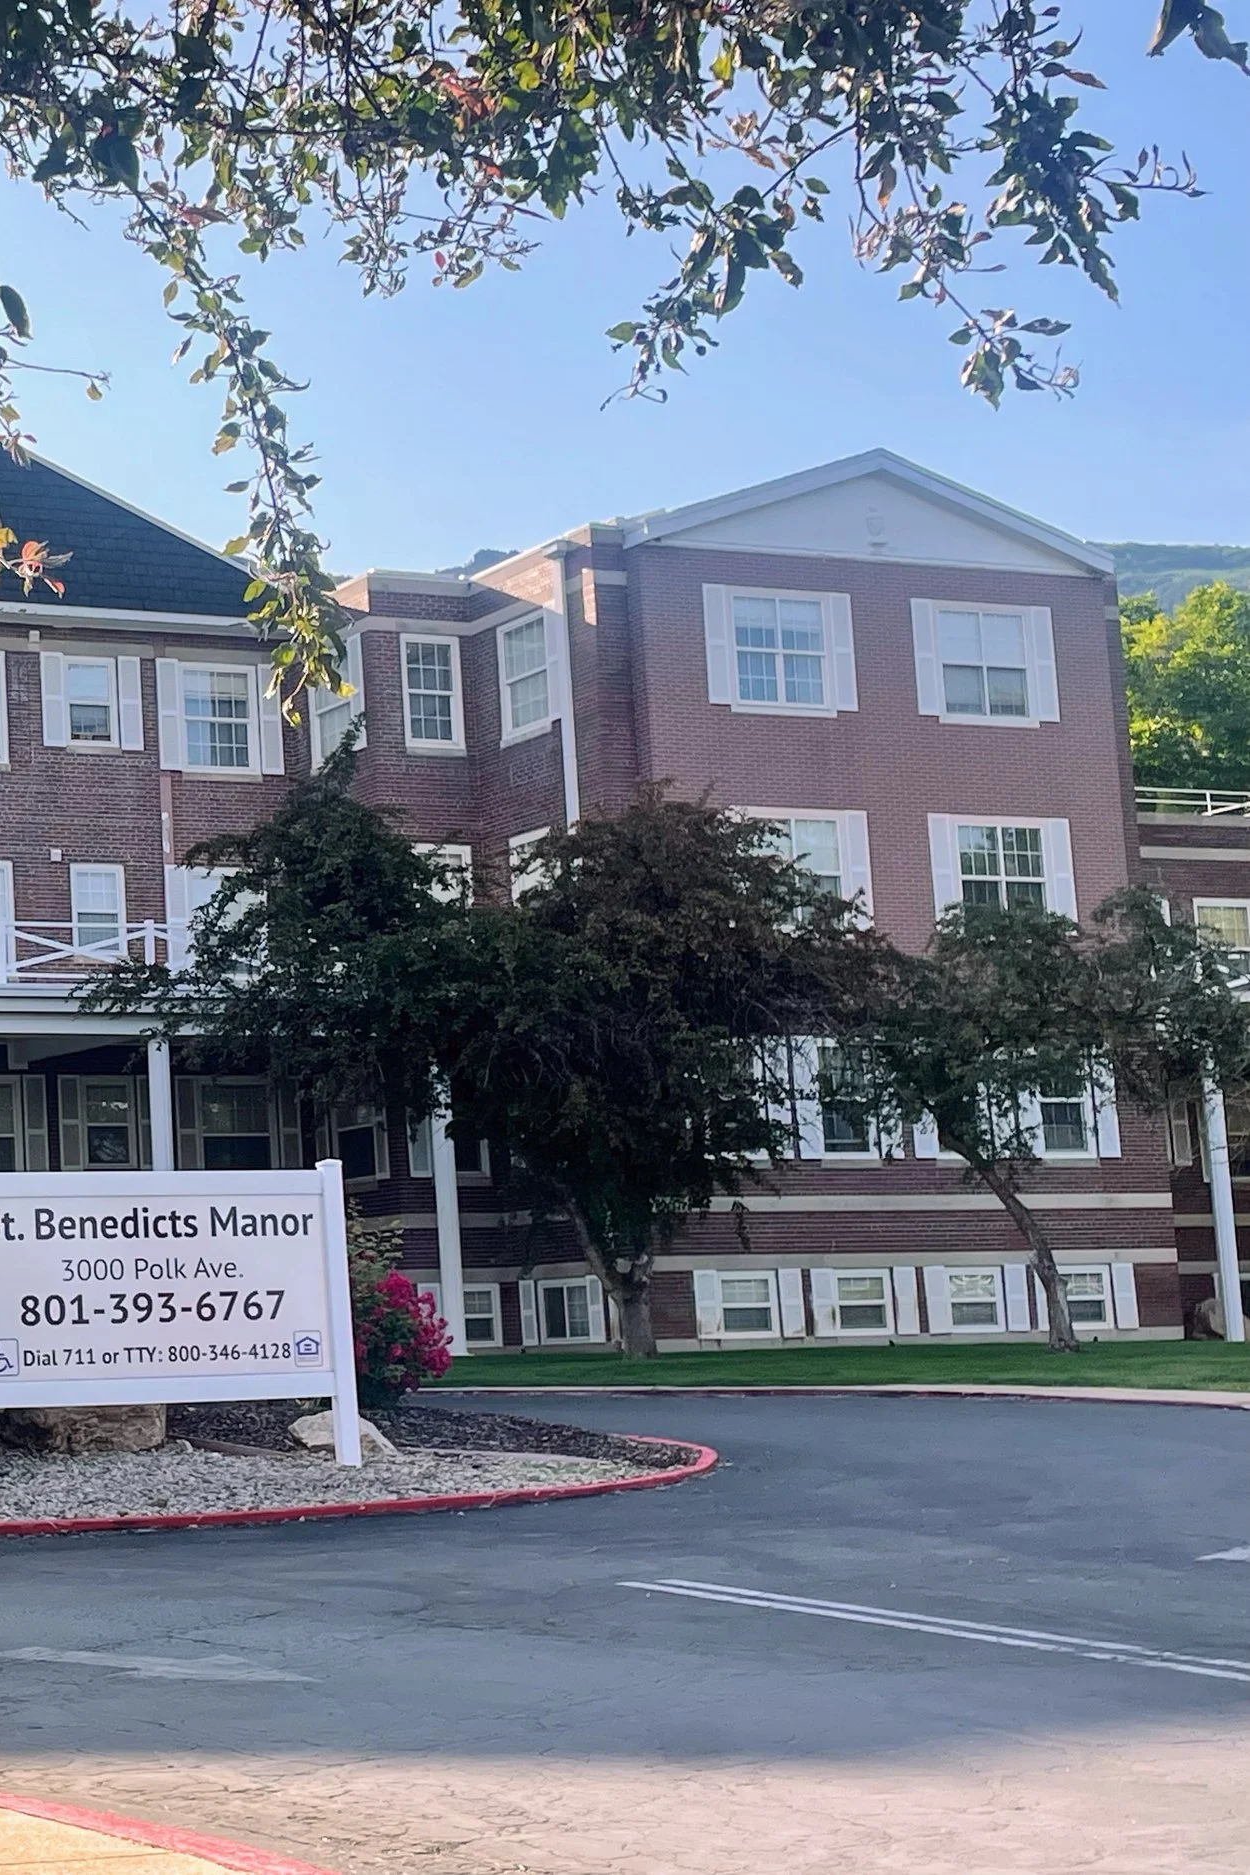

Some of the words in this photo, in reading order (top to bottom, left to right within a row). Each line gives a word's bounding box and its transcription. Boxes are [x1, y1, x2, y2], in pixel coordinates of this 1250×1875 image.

[35, 1207, 198, 1240] Benedicts
[210, 1206, 313, 1237] Manor
[62, 1259, 124, 1281] 3000
[135, 1257, 187, 1280] Polk
[194, 1257, 243, 1278] Ave.
[21, 1290, 285, 1326] 801-393-6767
[23, 1349, 58, 1367] Dial
[63, 1348, 96, 1365] 711
[102, 1352, 119, 1364] or
[123, 1346, 163, 1363] TTY:
[168, 1343, 291, 1362] 800-346-4128
